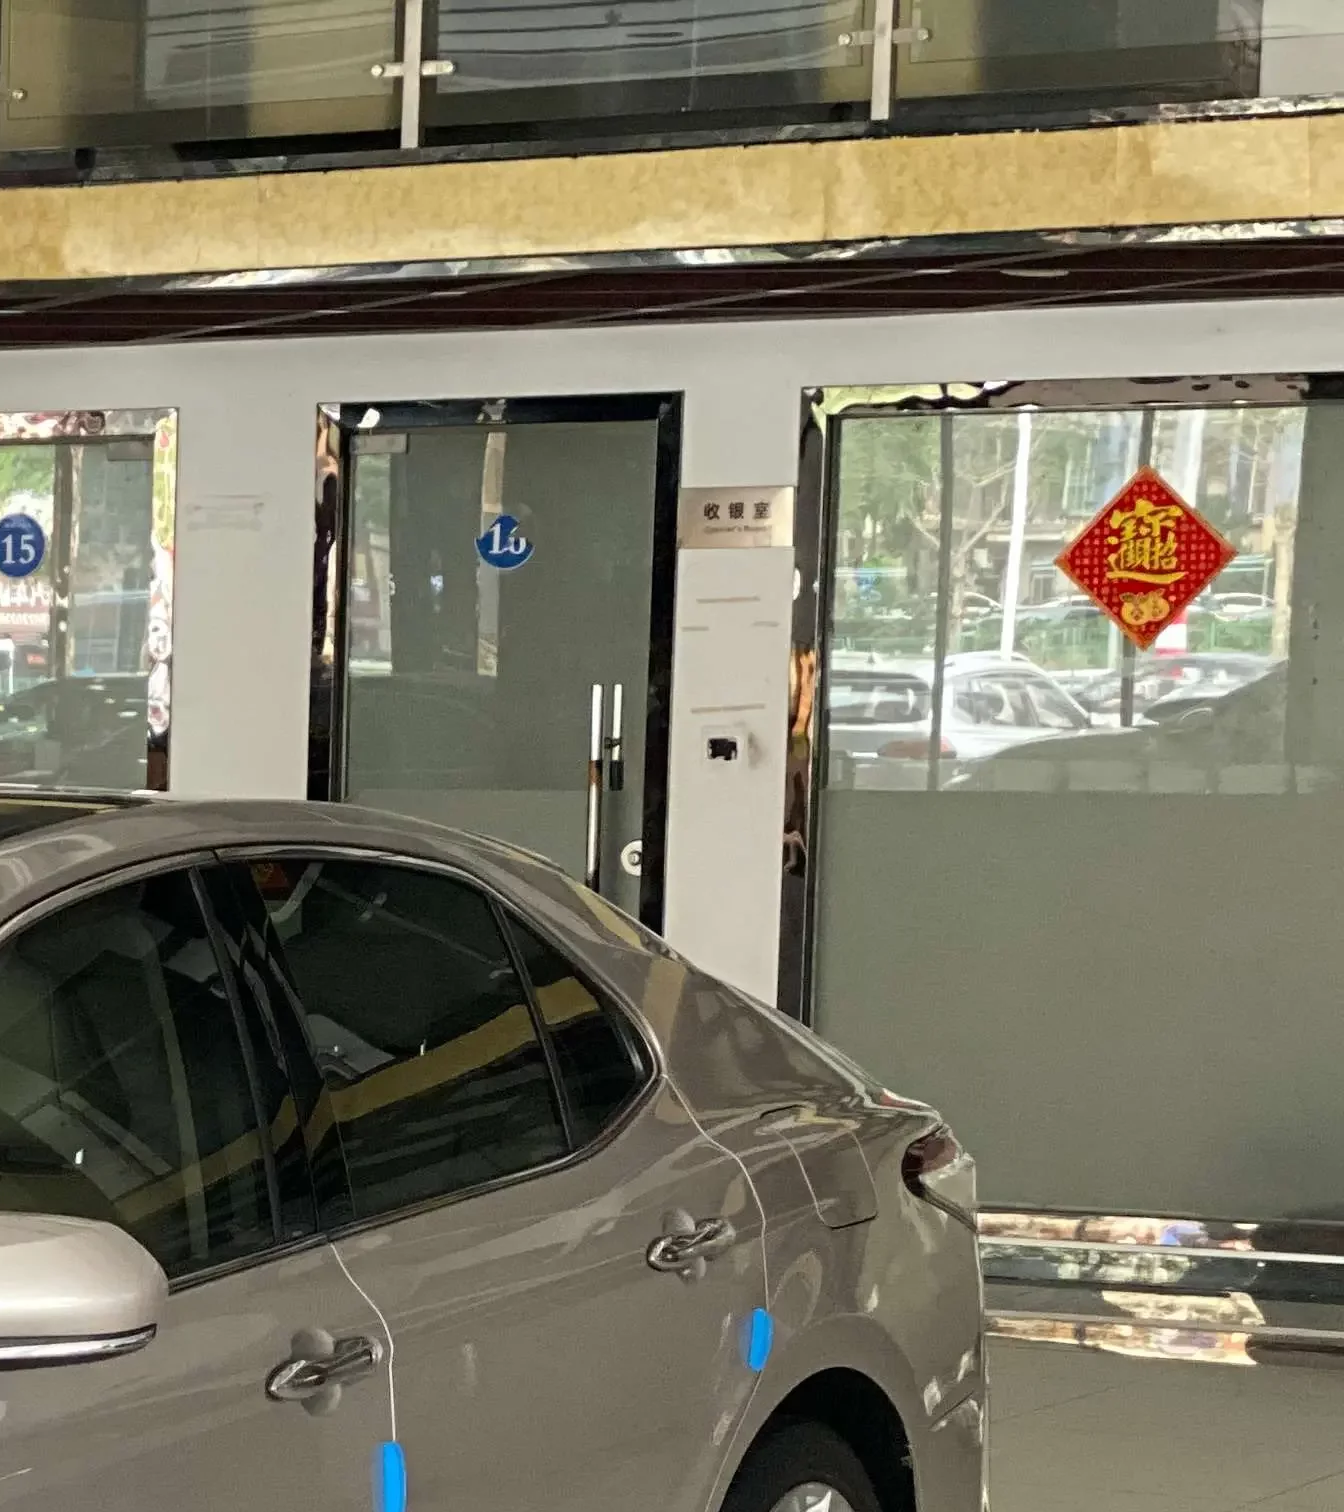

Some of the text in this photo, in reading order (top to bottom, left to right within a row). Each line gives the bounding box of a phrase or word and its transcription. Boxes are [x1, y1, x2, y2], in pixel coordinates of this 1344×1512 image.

[703, 501, 770, 520] 收银室
[1, 534, 36, 564] 15
